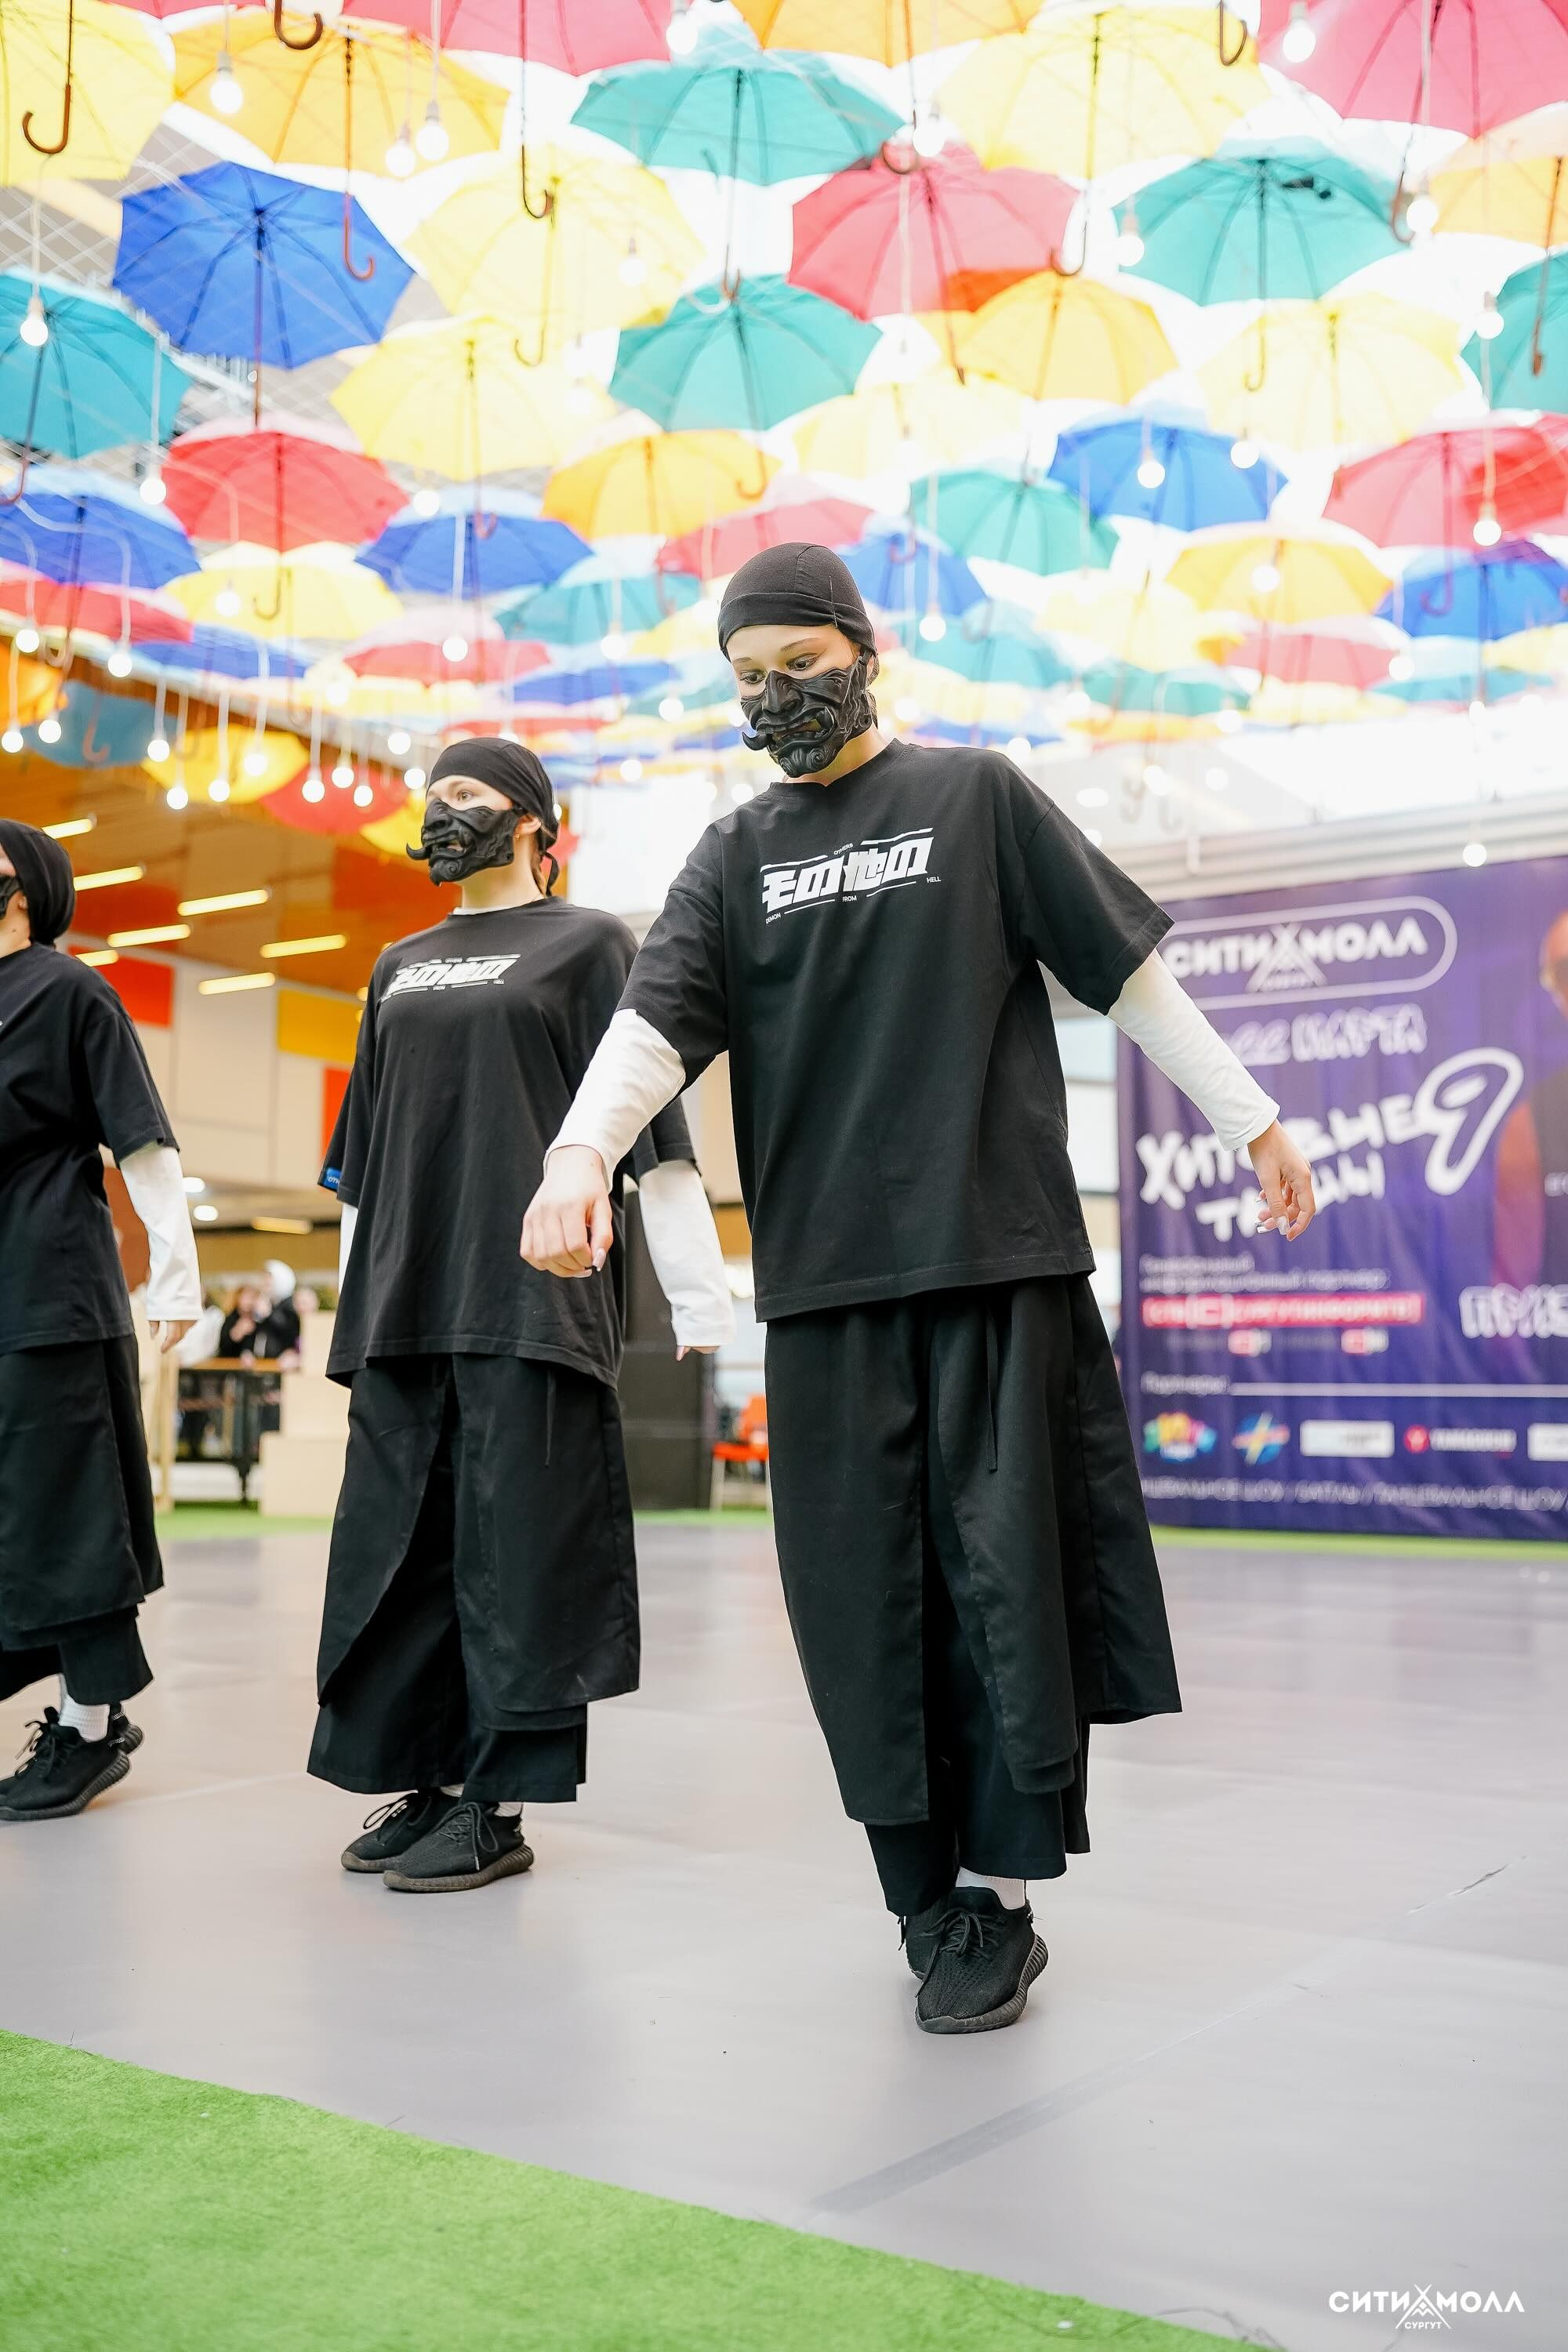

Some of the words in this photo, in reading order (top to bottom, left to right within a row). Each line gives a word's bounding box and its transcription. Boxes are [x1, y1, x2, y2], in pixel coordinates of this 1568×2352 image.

[833, 842, 854, 855] OTHERS
[765, 912, 782, 924] DEMON
[842, 895, 858, 903] FROM
[1163, 932, 1273, 979] СИТИ
[1298, 916, 1428, 964] МОЛЛ
